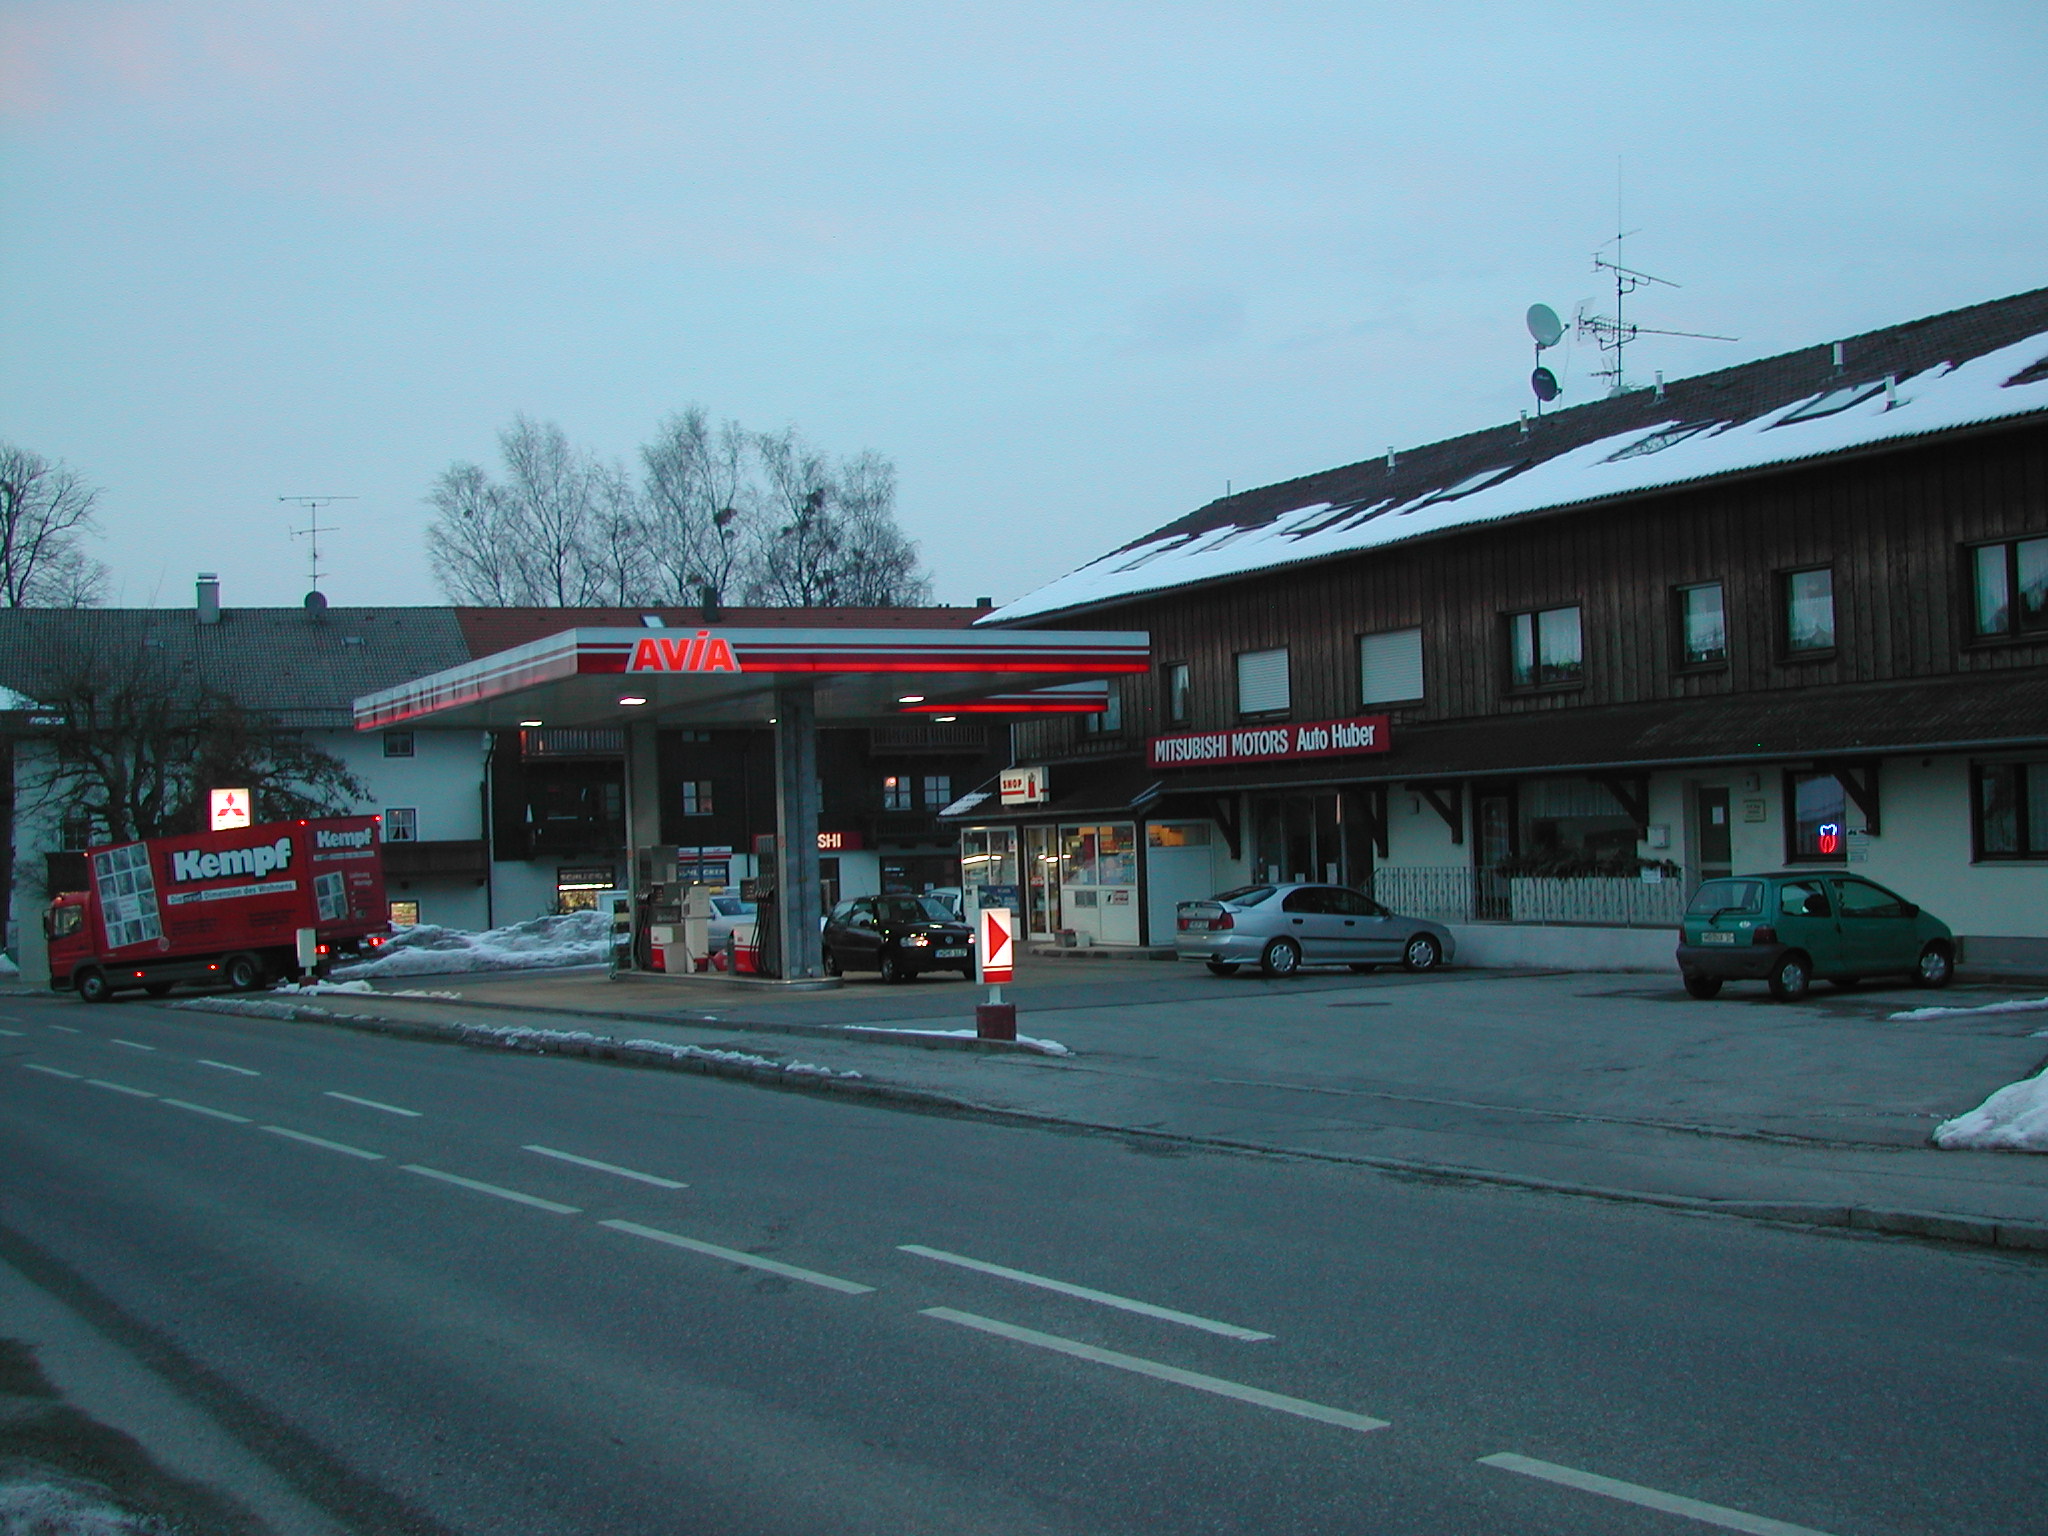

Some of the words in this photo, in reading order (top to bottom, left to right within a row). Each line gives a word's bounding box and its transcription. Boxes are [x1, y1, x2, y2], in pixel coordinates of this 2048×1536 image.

[1154, 734, 1228, 763] MITSUBISHI
[1231, 728, 1290, 757] MOTORS
[1296, 727, 1329, 752] Auto
[1332, 722, 1376, 749] Huber
[1002, 779, 1023, 790] SHOP
[316, 828, 373, 850] Kempf
[172, 836, 293, 882] Kempf
